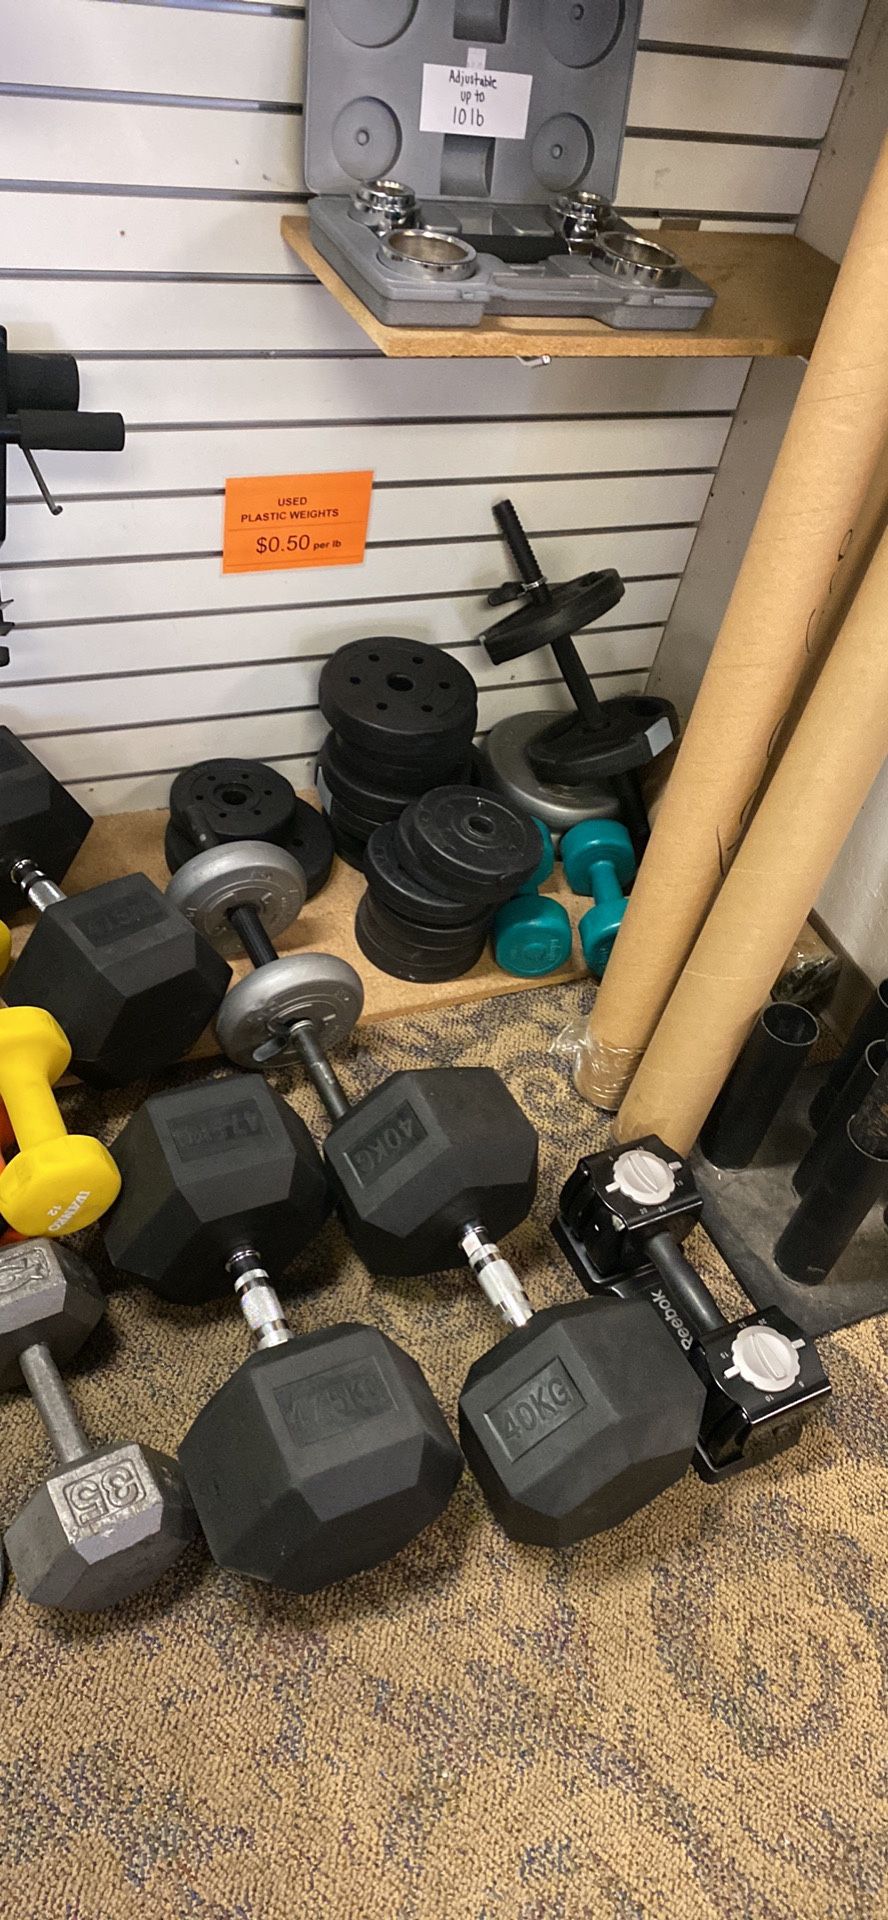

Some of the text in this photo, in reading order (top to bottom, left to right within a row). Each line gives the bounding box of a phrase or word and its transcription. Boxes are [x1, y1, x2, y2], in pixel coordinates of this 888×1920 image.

[449, 69, 498, 89] Adjustable
[460, 90, 486, 105] up to
[453, 106, 485, 127] 10 lb
[278, 496, 308, 507] USED
[240, 508, 339, 523] PLASTIC WEIGHTS
[256, 534, 342, 554] $0.50 per lb
[353, 1118, 414, 1178] 40KG
[47, 1205, 62, 1216] 12
[48, 1190, 91, 1231] IVANKO
[650, 1288, 694, 1351] Reebok
[503, 1377, 573, 1440] 40KG
[69, 1465, 140, 1525] 35
